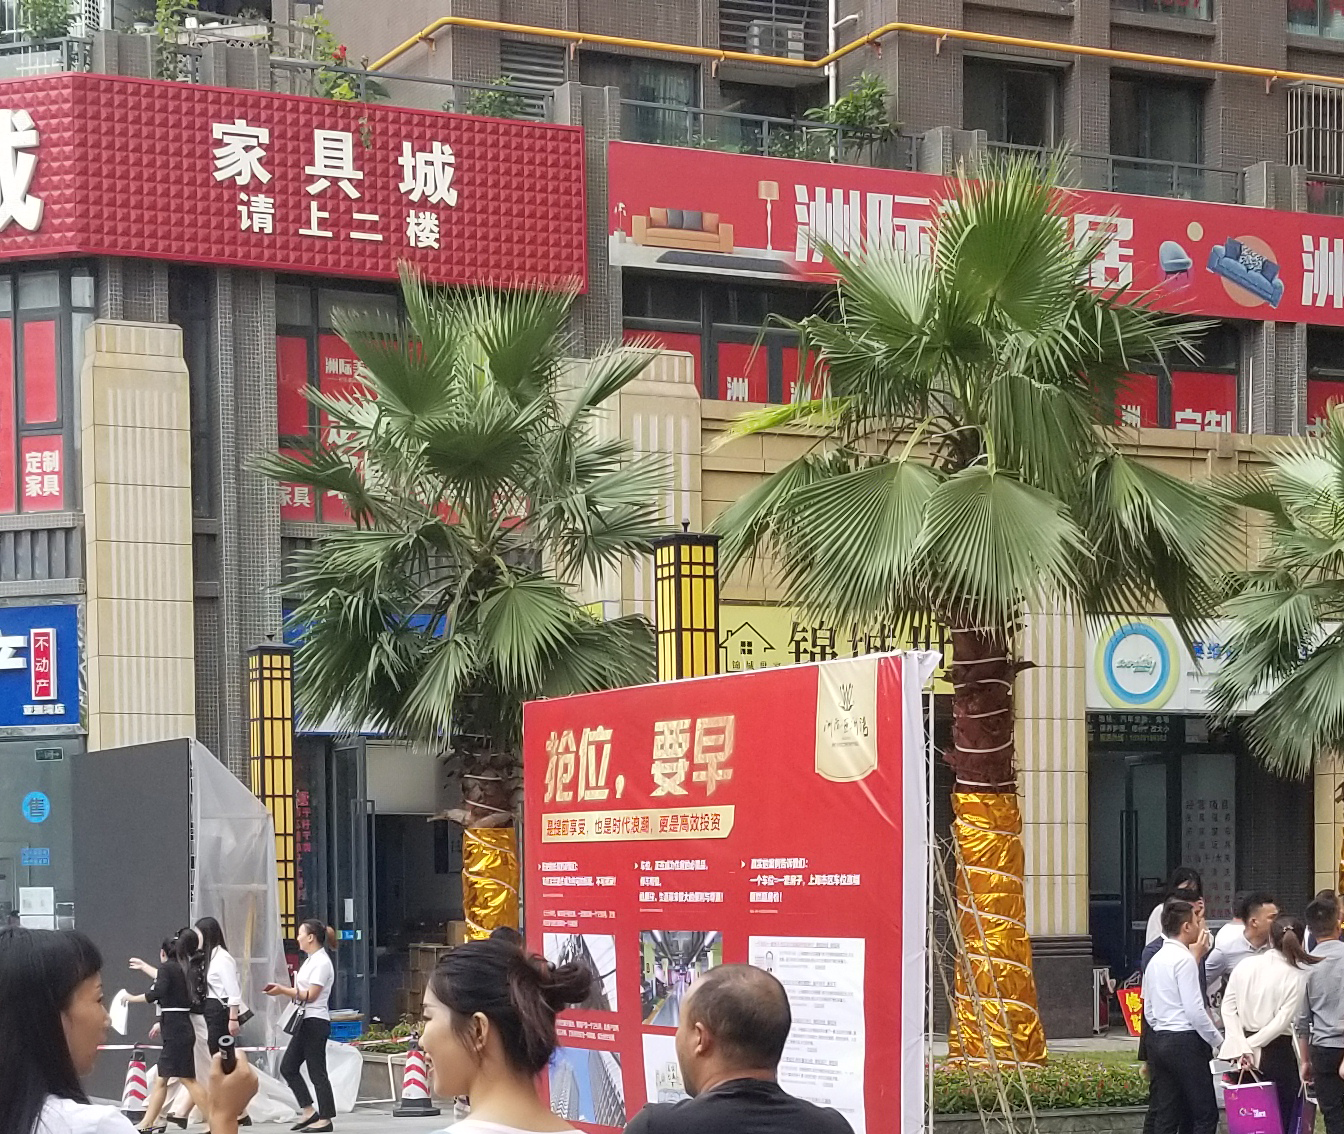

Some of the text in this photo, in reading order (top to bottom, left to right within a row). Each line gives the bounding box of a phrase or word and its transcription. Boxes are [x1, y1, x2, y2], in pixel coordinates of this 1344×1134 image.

[212, 119, 458, 207] 家具城
[238, 192, 441, 250] 请上二楼
[25, 449, 59, 474] 定制
[24, 474, 60, 498] 家具
[34, 636, 50, 695] 不动产
[27, 796, 46, 817] 售
